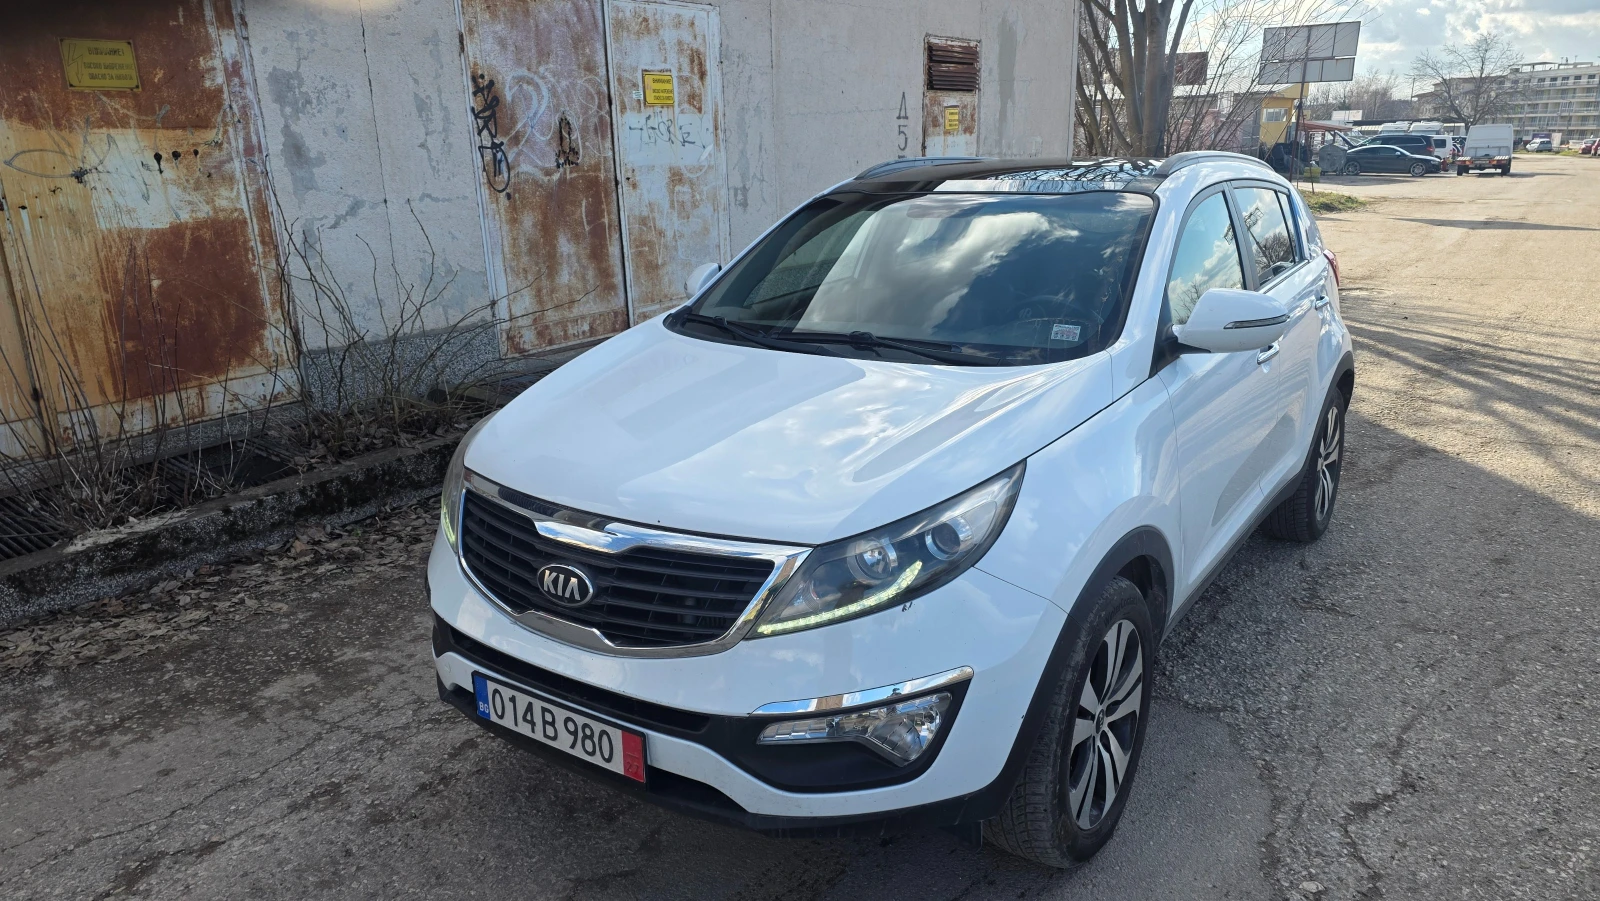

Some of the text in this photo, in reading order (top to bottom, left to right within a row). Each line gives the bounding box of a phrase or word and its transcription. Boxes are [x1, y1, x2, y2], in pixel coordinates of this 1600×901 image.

[898, 125, 908, 151] 5
[544, 570, 580, 600] KIA
[479, 702, 489, 714] BG
